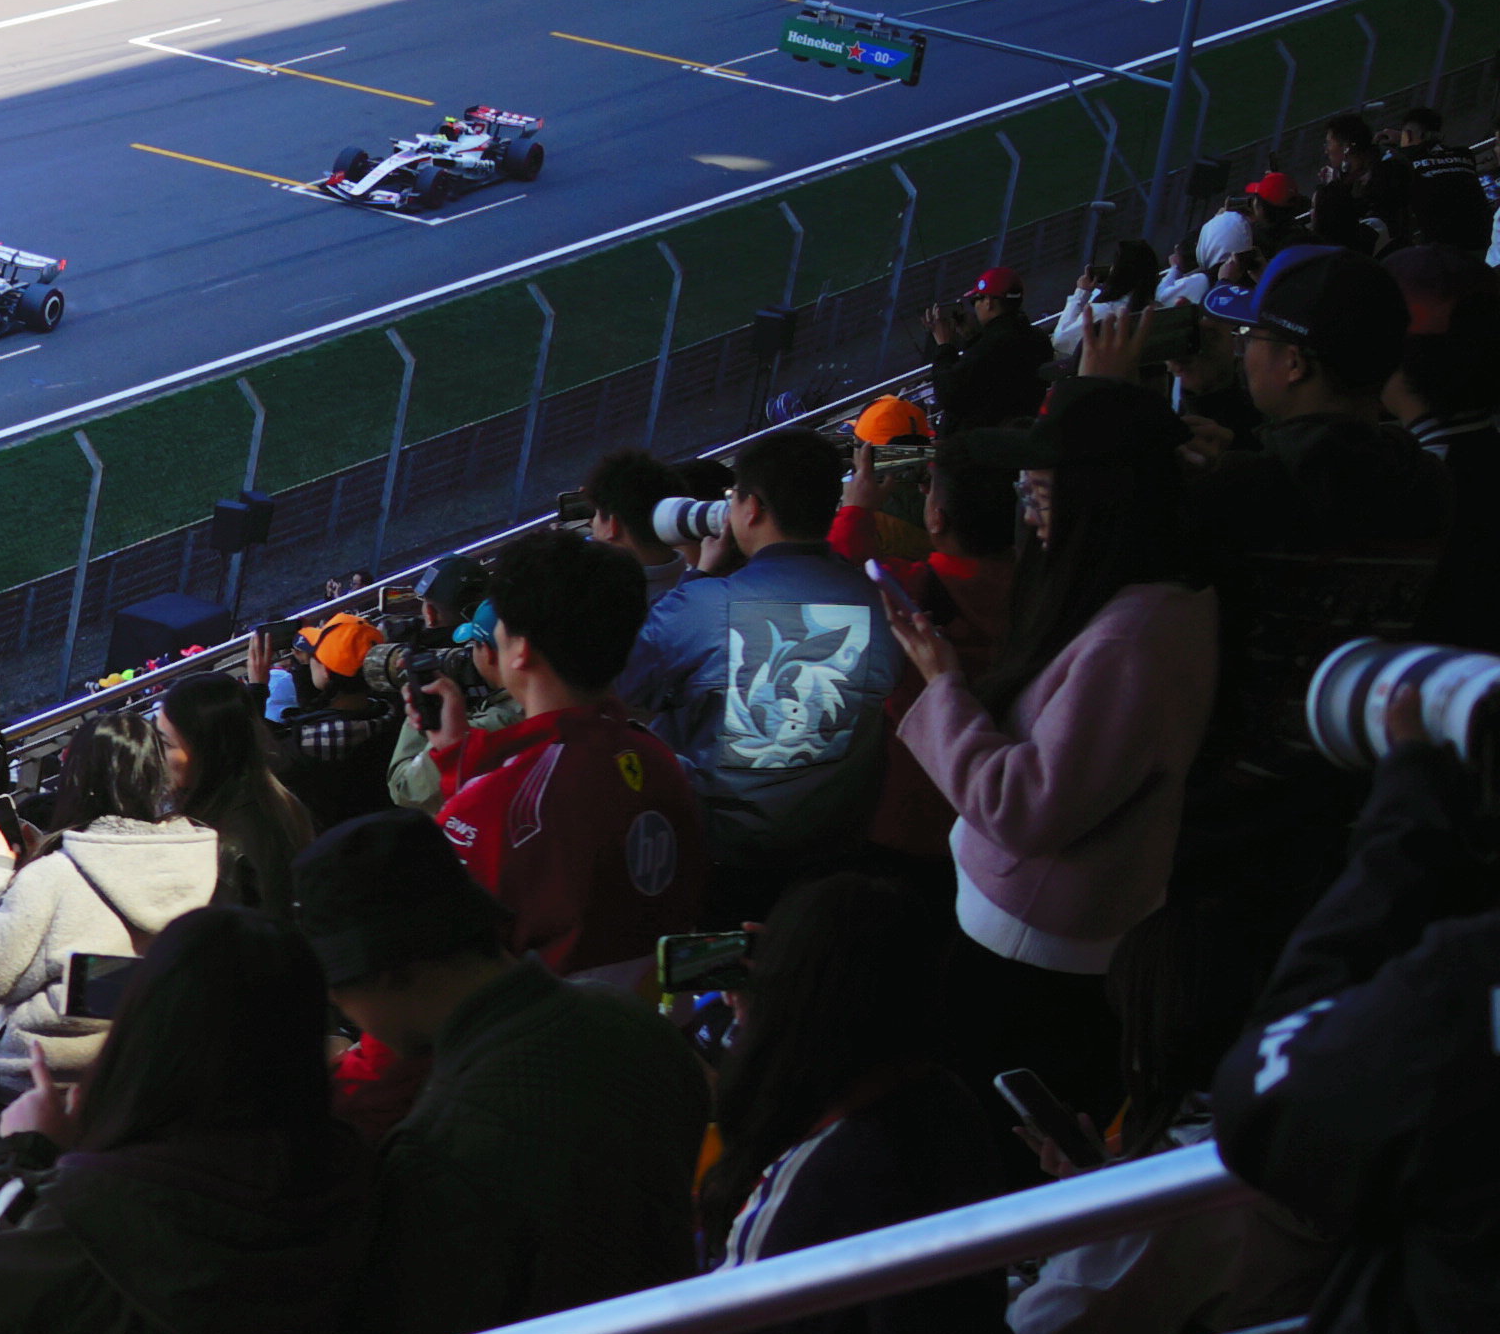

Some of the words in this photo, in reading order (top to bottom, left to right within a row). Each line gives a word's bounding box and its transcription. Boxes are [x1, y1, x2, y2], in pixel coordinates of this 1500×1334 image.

[787, 29, 844, 54] Heineken
[446, 816, 479, 833] aws
[634, 817, 671, 897] hp
